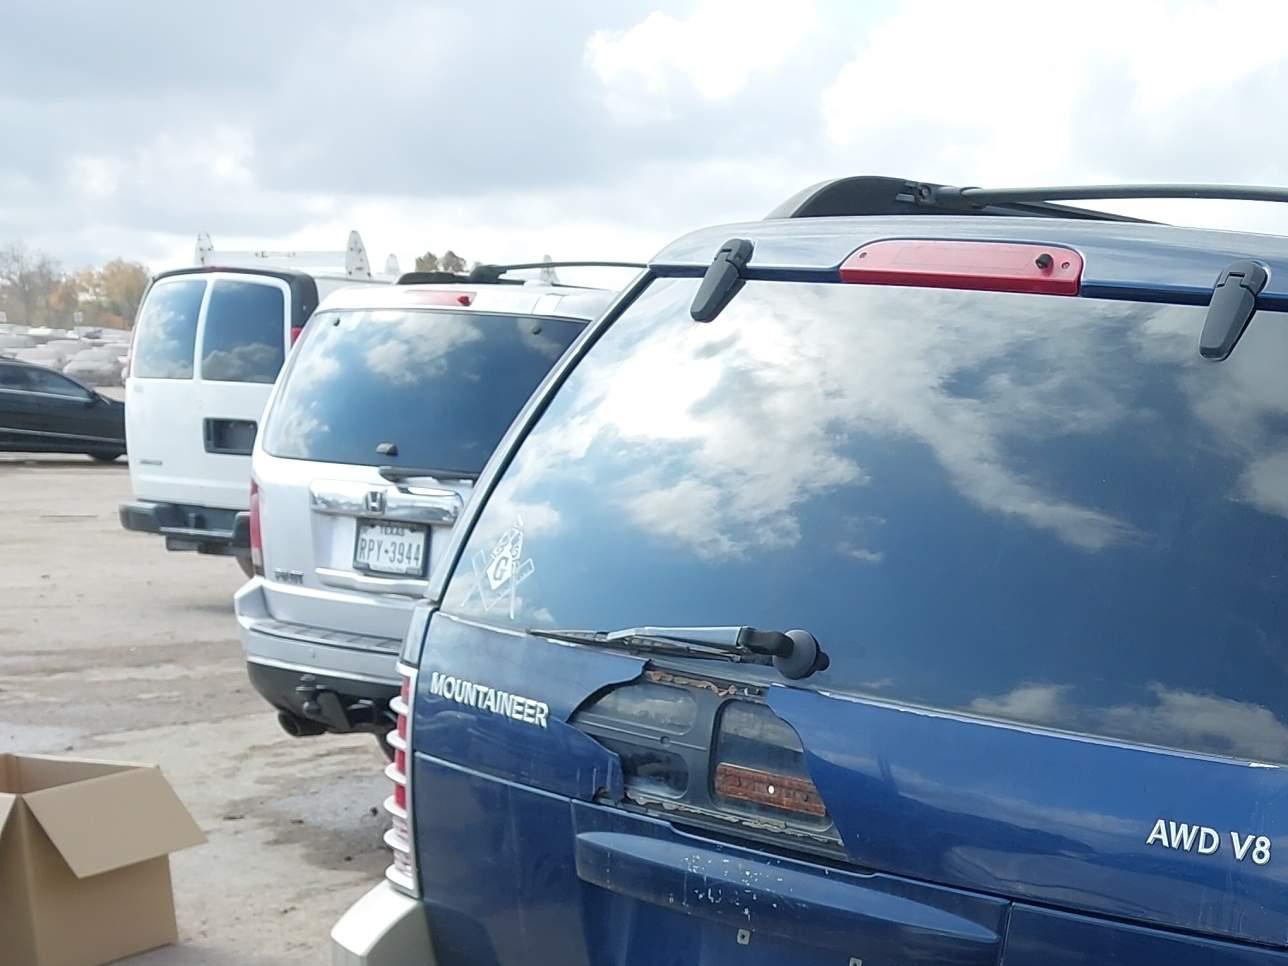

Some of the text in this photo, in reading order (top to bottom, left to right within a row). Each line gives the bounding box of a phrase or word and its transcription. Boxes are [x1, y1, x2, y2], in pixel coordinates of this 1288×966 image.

[430, 671, 549, 728] MOUNTAINEER
[1146, 819, 1271, 864] AWD V8
